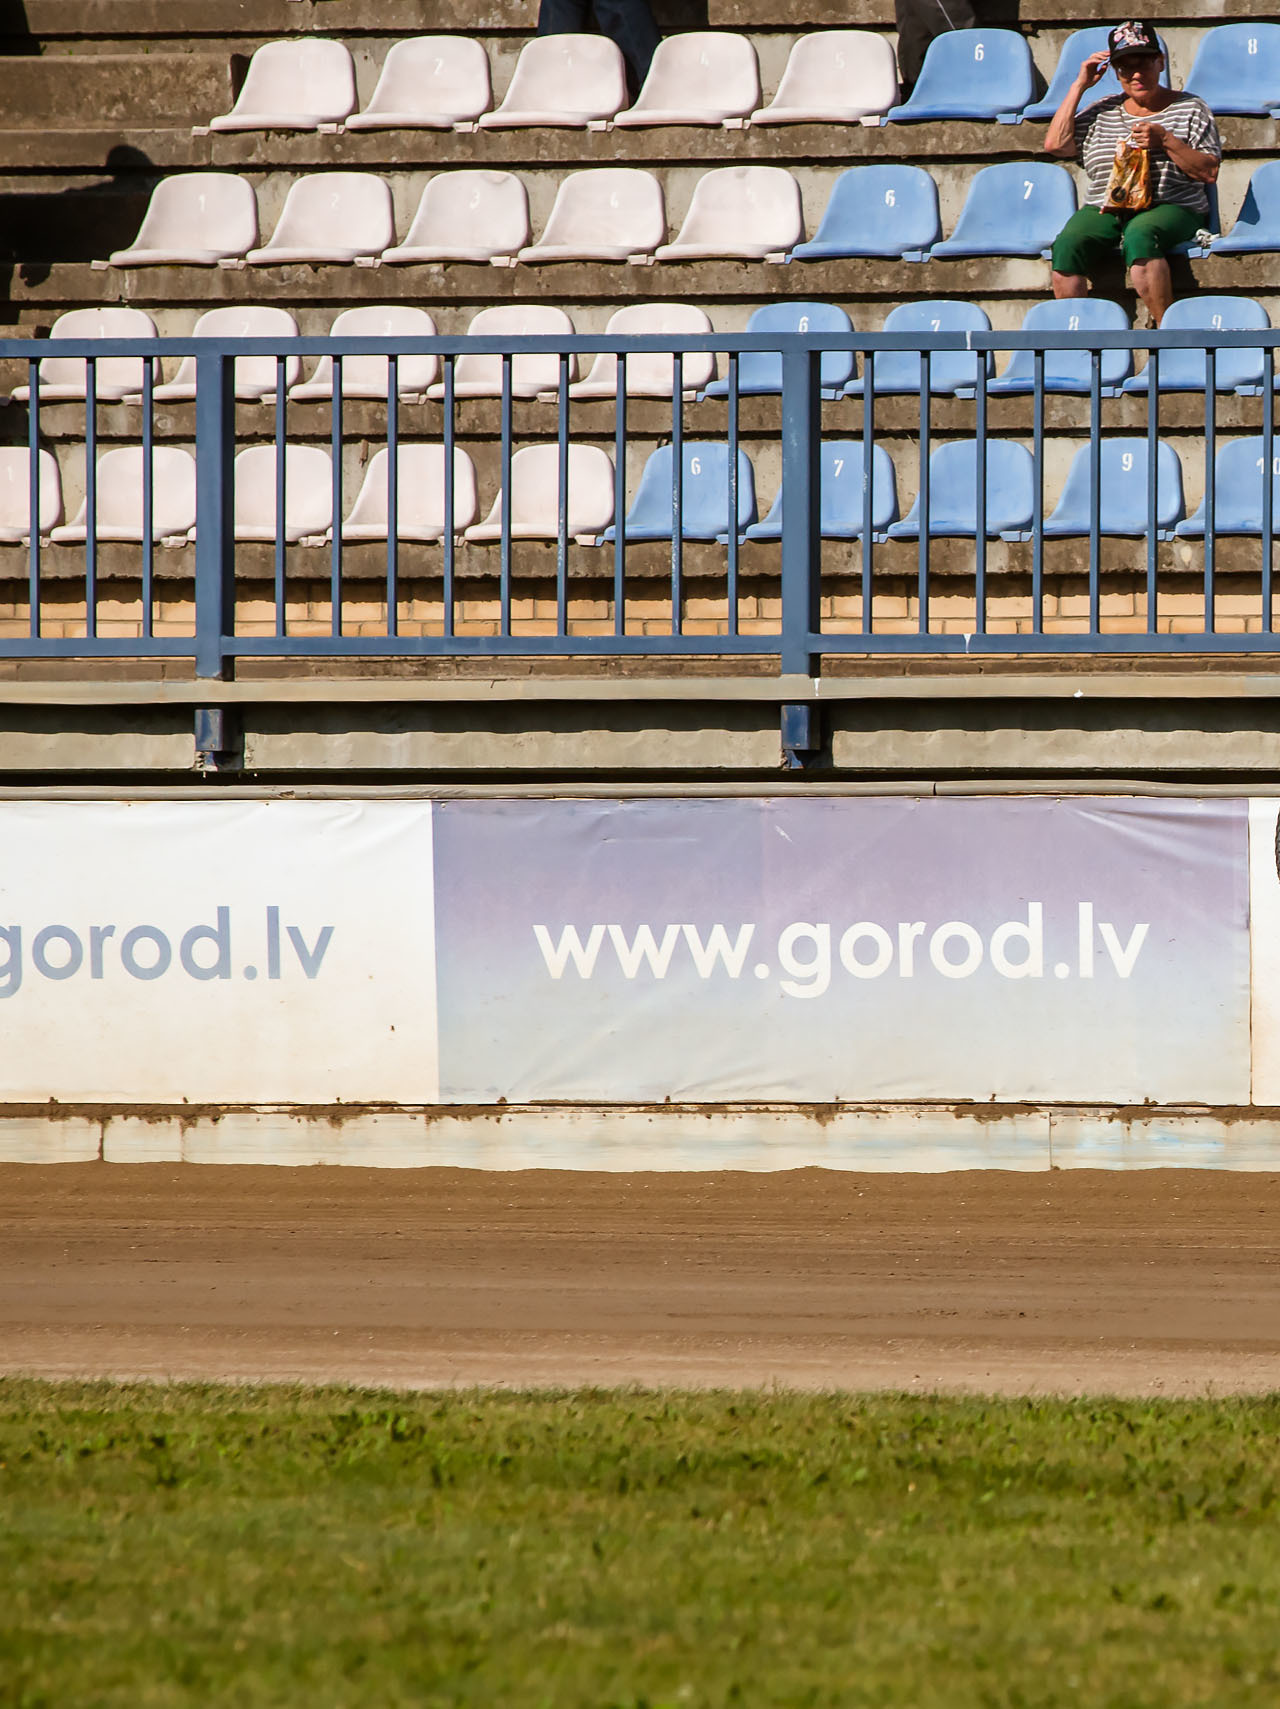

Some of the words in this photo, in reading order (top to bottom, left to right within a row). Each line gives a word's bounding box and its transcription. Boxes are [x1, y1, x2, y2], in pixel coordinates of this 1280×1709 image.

[974, 43, 985, 61] 6
[1247, 38, 1258, 55] 8
[885, 189, 896, 207] 6
[1023, 180, 1034, 200] 7
[798, 316, 809, 333] 6
[690, 456, 701, 475] 6
[834, 459, 844, 477] 7
[1121, 452, 1133, 472] 9
[532, 902, 1150, 998] www.gorod.lv
